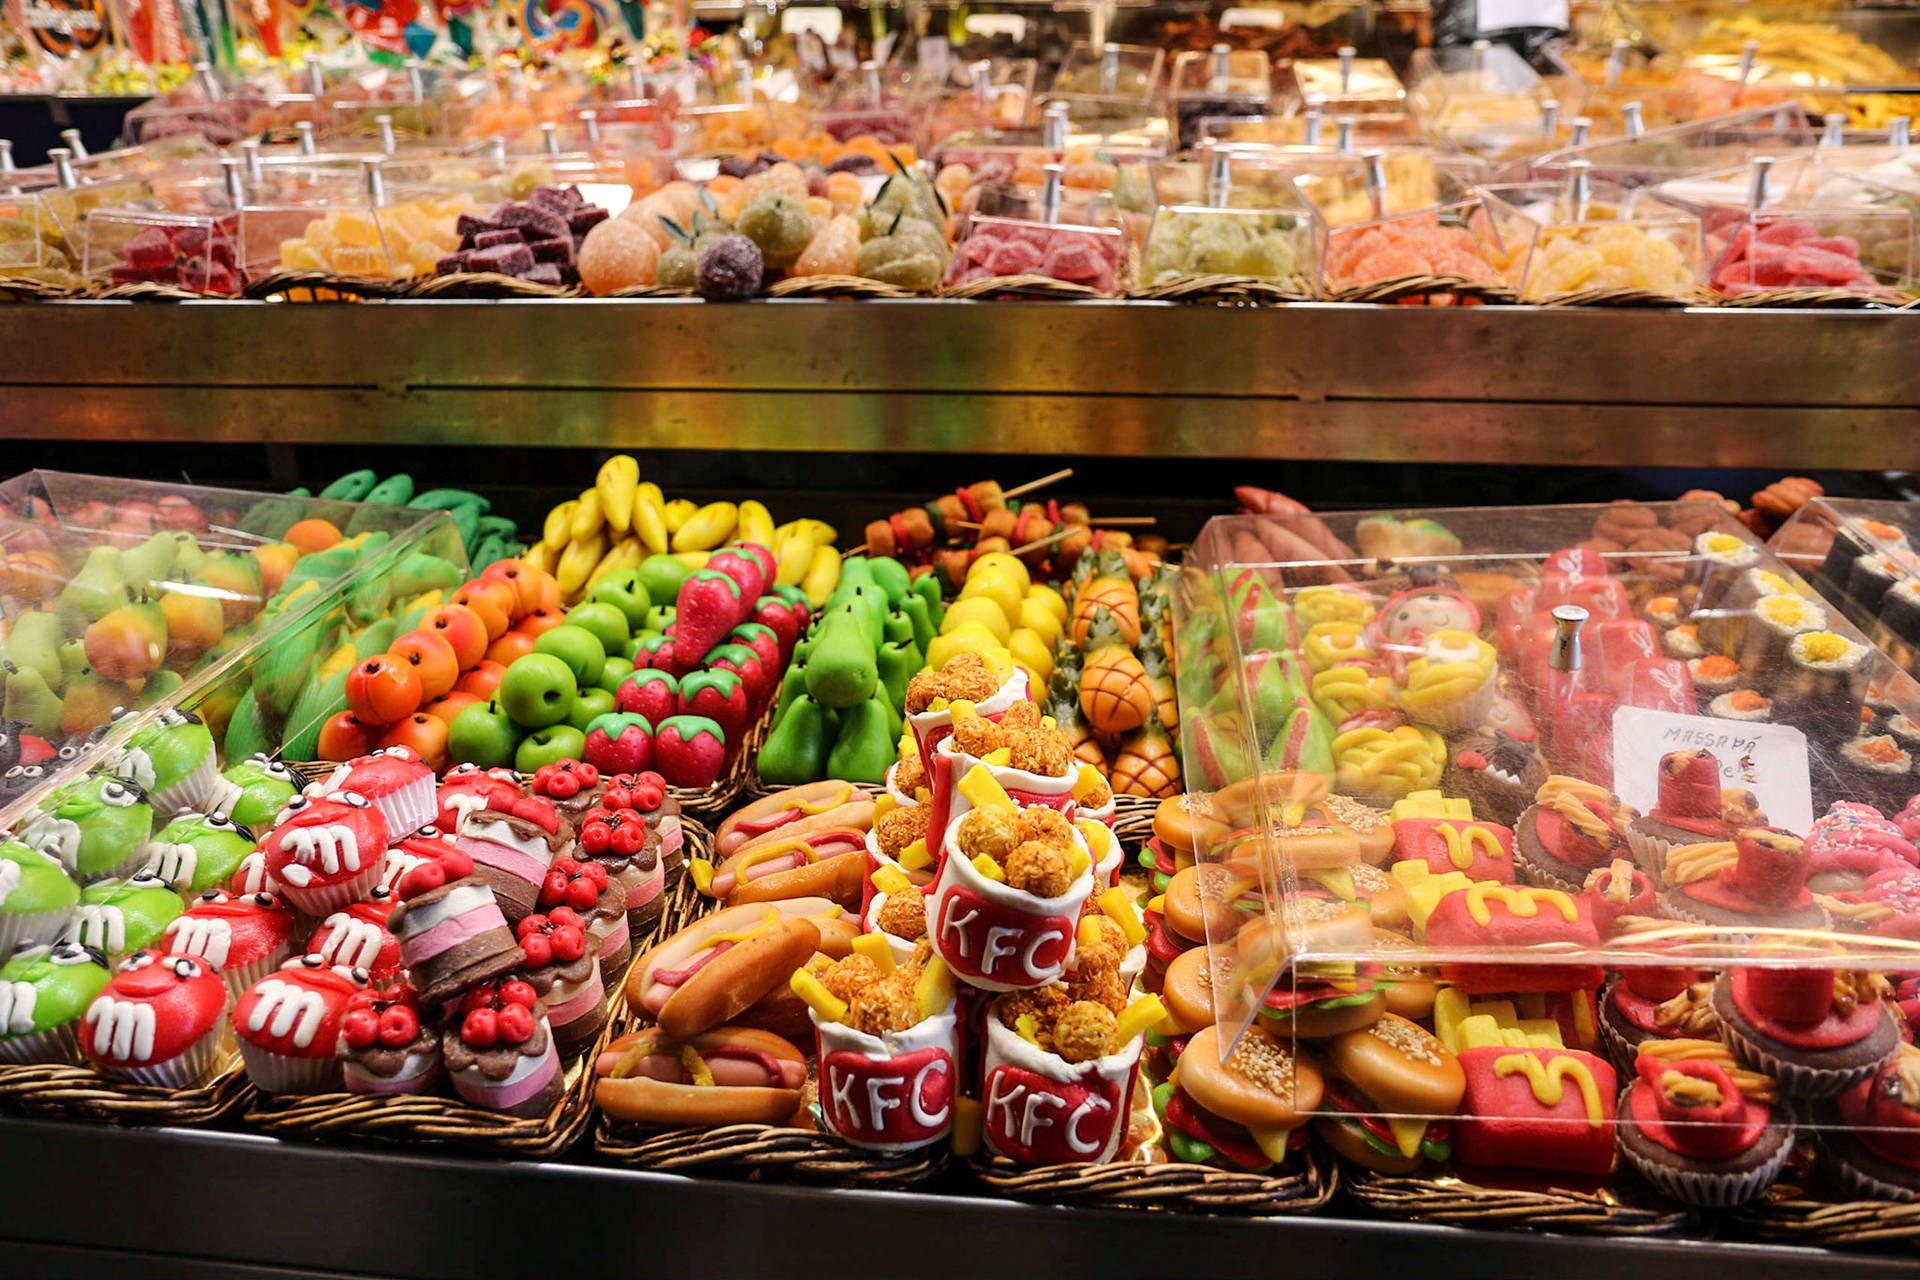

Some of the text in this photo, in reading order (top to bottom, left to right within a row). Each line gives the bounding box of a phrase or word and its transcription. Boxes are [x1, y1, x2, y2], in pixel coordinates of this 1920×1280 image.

[166, 916, 232, 969] m
[314, 912, 383, 970] m
[941, 895, 1064, 979] KFC
[86, 995, 156, 1061] m
[248, 979, 325, 1048] m
[829, 1059, 950, 1131] KFC
[987, 1070, 1112, 1154] KFC
